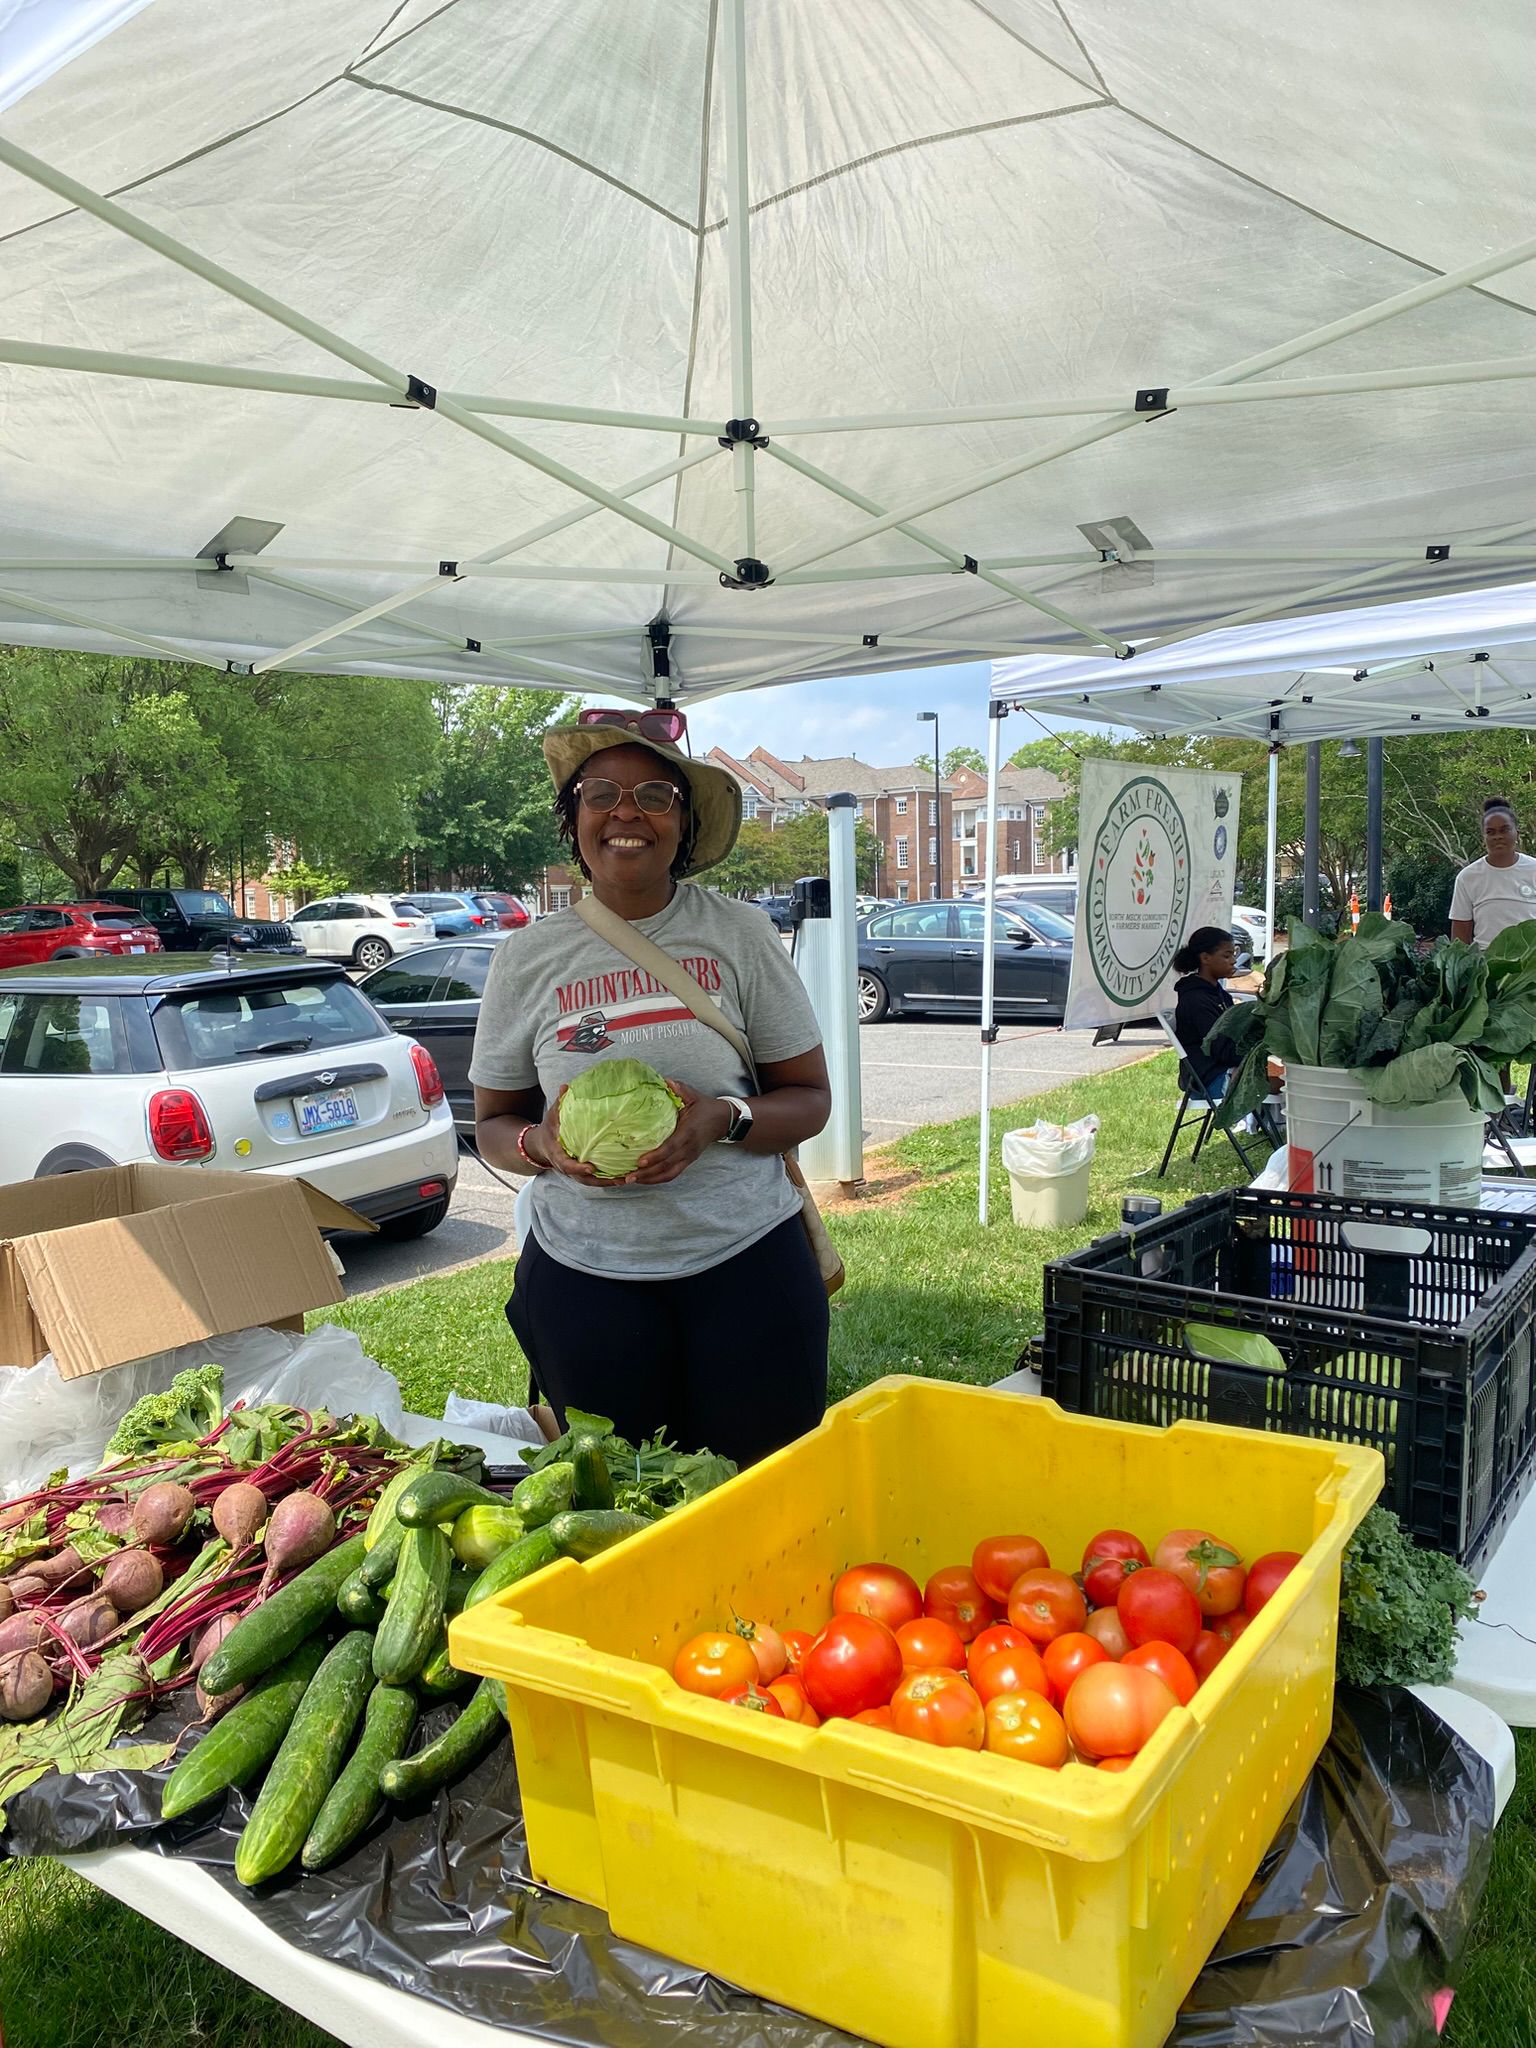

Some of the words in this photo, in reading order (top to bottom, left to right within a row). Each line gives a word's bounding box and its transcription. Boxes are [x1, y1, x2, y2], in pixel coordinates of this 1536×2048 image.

[1101, 788, 1142, 856] FARM
[1146, 788, 1185, 855] FRESH
[1093, 878, 1145, 996] COMMUNITY
[1149, 877, 1185, 983] STRONG
[621, 1029, 655, 1045] MOUNT
[657, 1024, 690, 1039] PISGAH
[302, 1098, 355, 1125] JMX-5818
